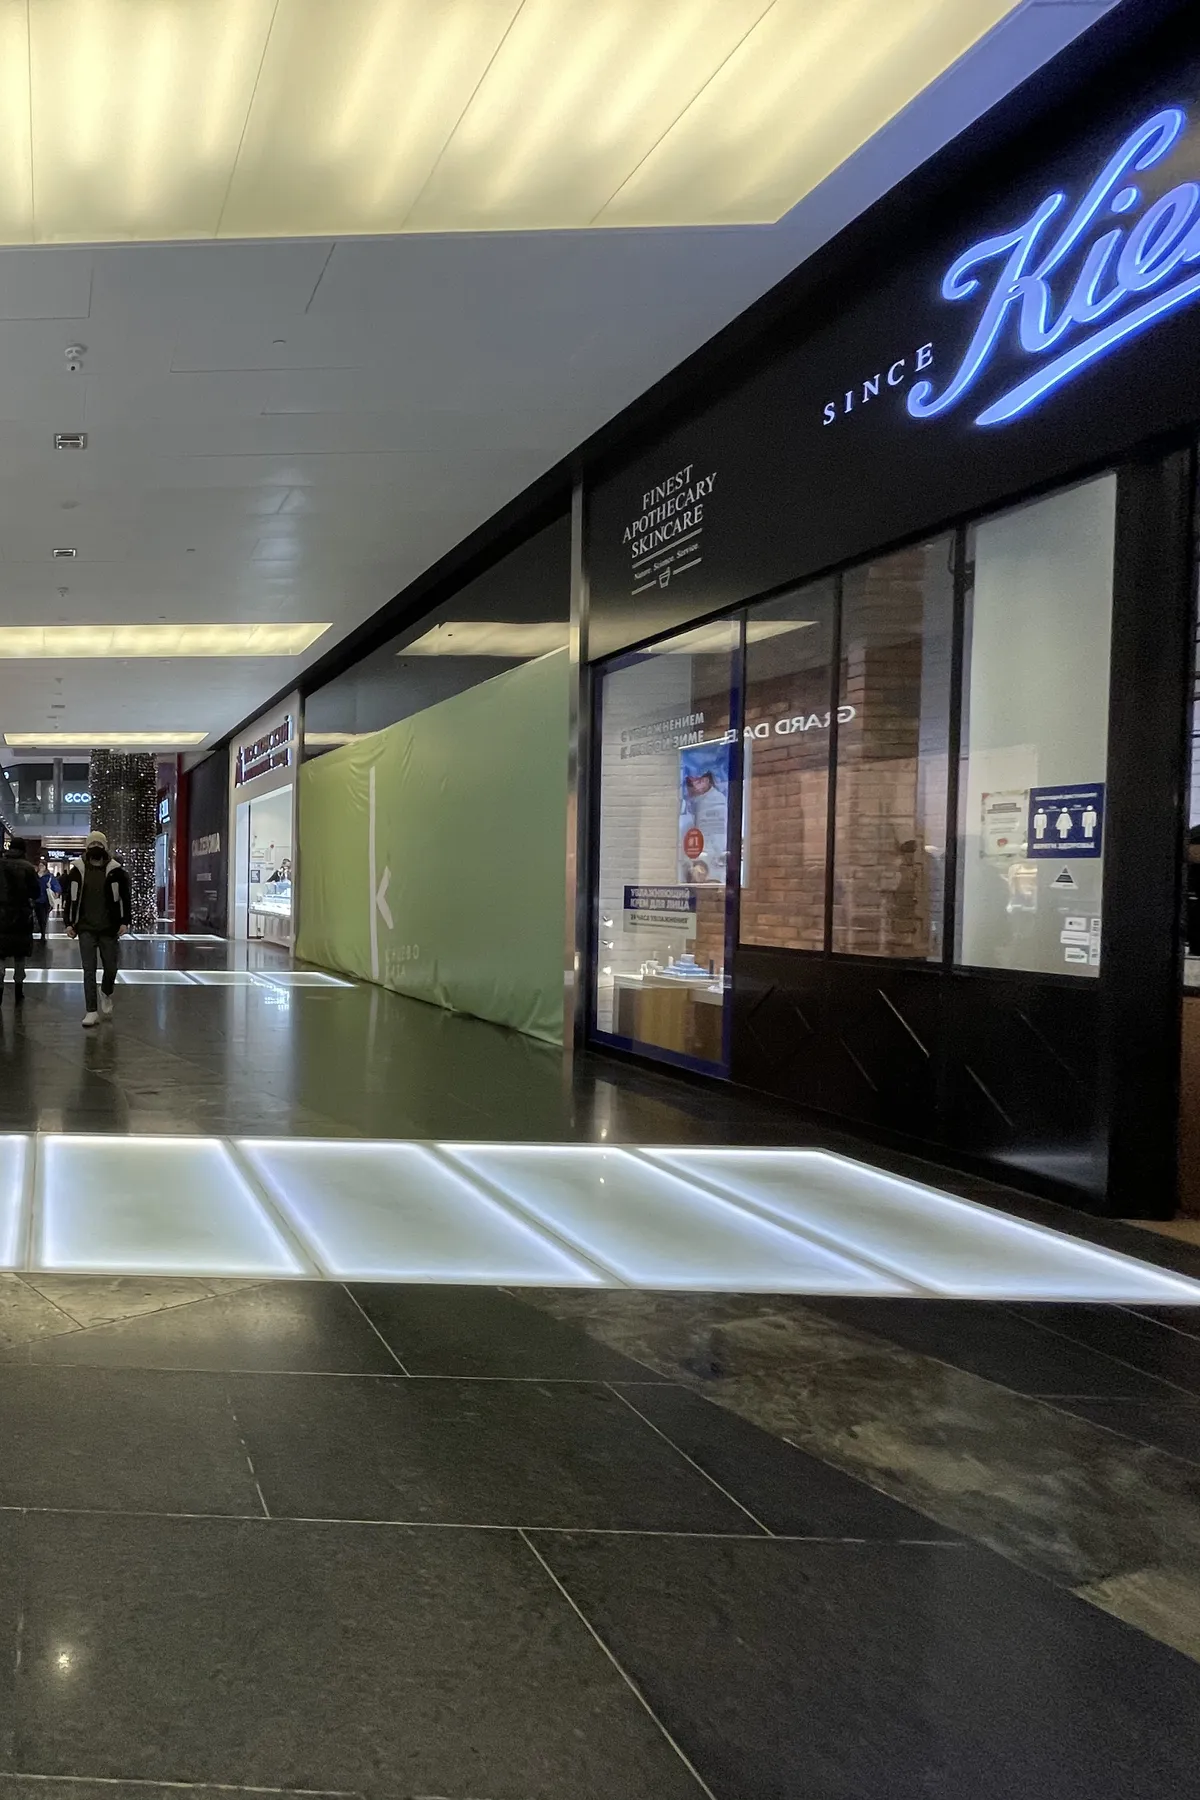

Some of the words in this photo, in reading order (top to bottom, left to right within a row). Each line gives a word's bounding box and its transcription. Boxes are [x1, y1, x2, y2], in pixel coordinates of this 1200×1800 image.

[906, 109, 1200, 418] Kie
[822, 342, 934, 426] SINCE
[622, 472, 717, 544] APOTHECARY
[642, 464, 693, 511] FINEST
[631, 504, 704, 559] SKINCARE
[672, 730, 705, 749] ЗИМЕ
